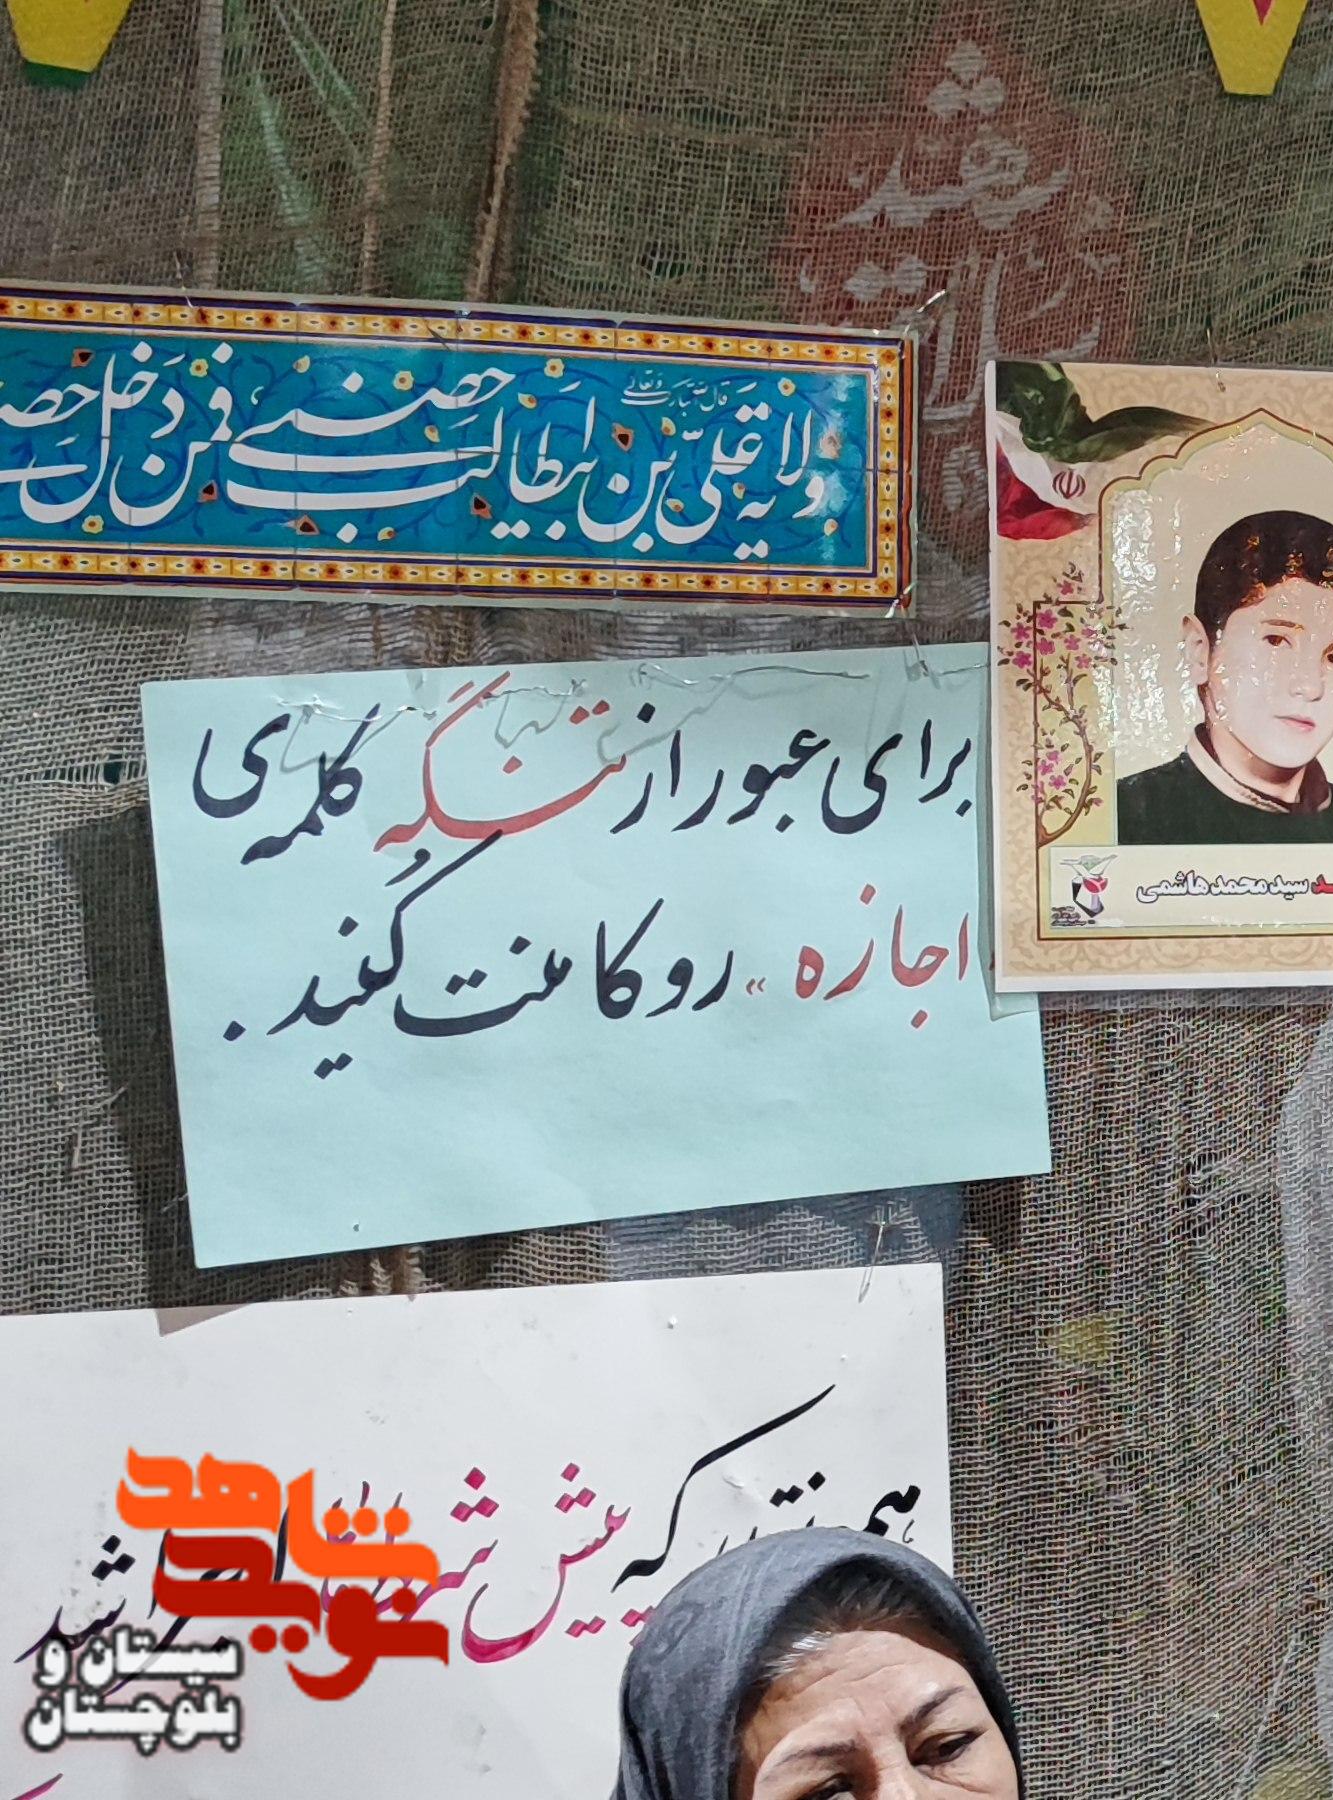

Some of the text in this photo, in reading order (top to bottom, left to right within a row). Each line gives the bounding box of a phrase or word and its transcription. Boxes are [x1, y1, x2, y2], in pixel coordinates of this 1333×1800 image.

[373, 671, 630, 852] تنگه
[611, 702, 682, 834] از
[672, 726, 831, 833] عبور
[822, 717, 973, 835] برای
[1136, 870, 1210, 904] هاشمی
[1209, 875, 1269, 896] محمد
[1268, 875, 1310, 900] سید
[646, 949, 734, 1018] رو
